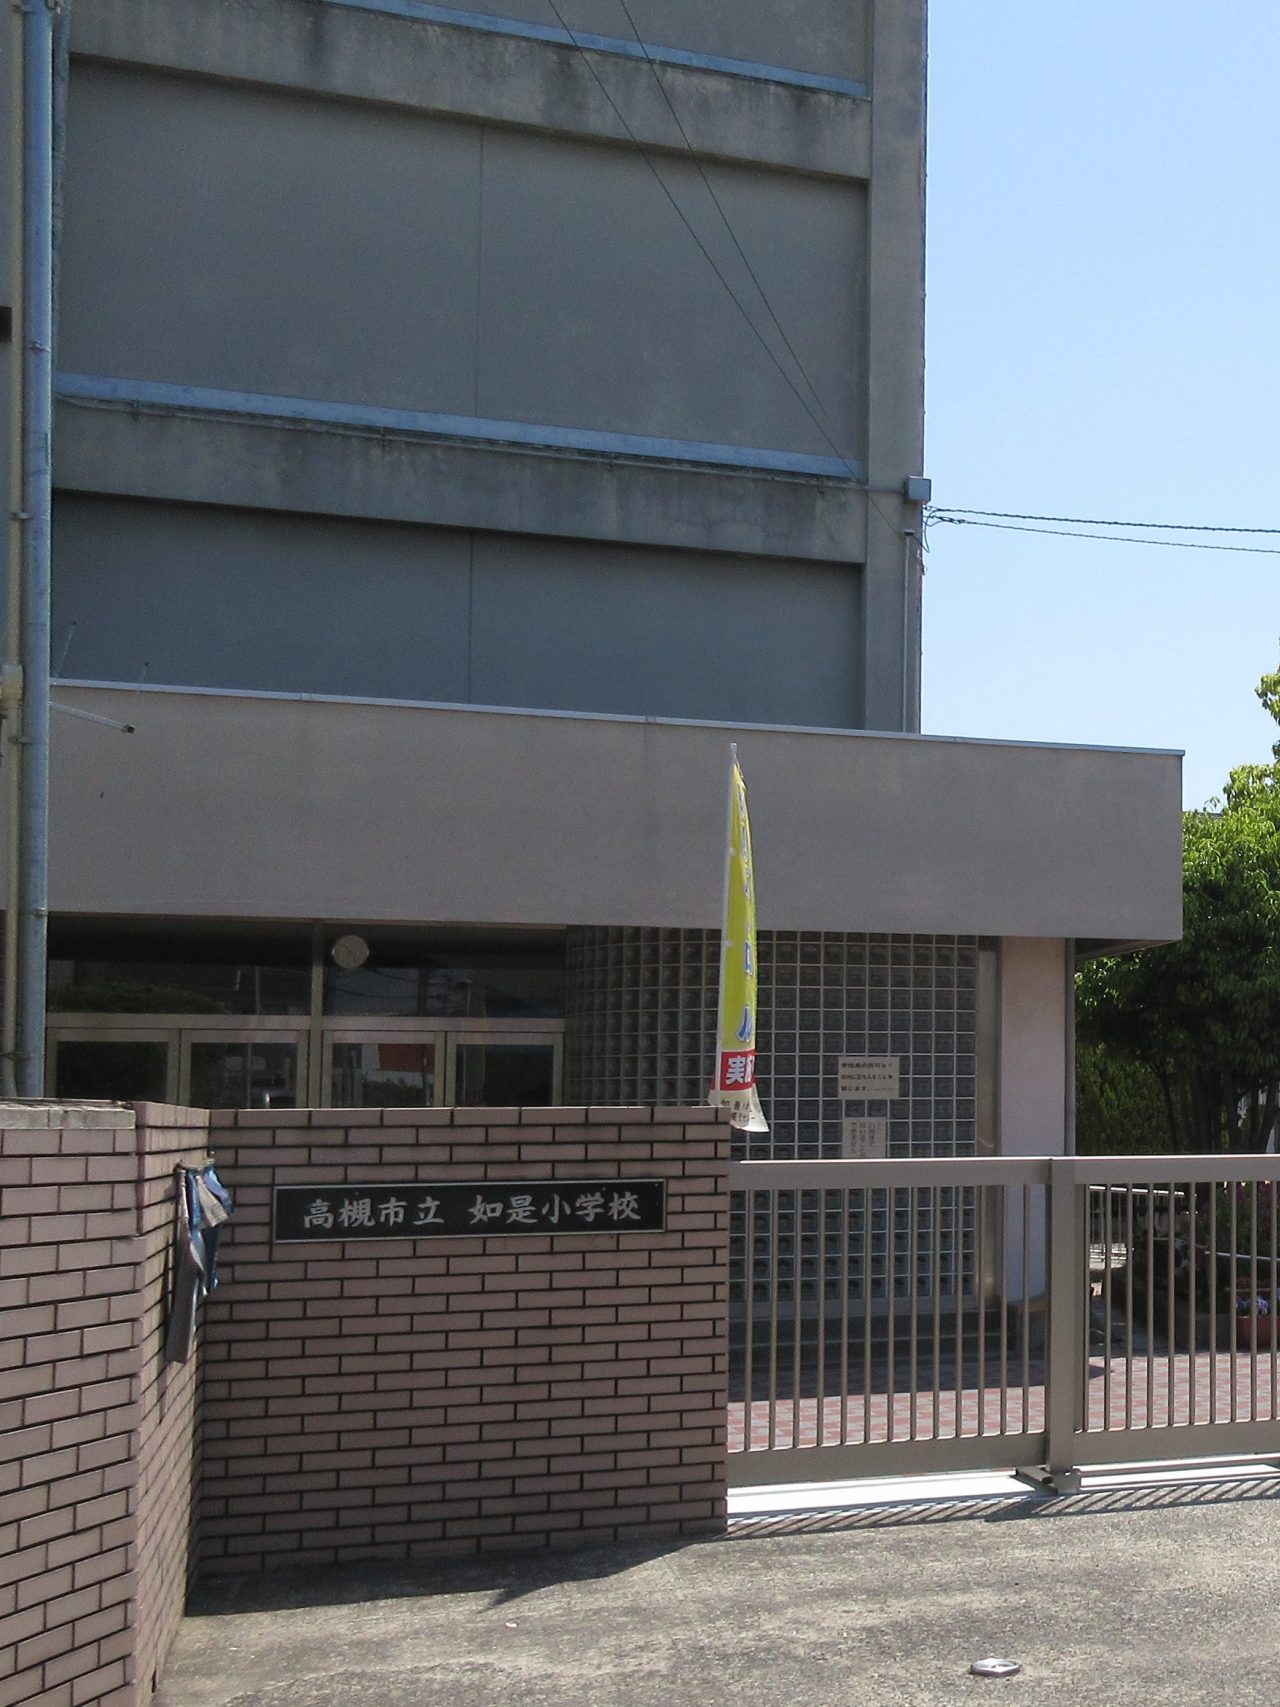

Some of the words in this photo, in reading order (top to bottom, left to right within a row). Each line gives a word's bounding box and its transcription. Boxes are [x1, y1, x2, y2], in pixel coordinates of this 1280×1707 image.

[302, 1196, 445, 1229] 高槻市立
[467, 1191, 642, 1225] 如是小学校
